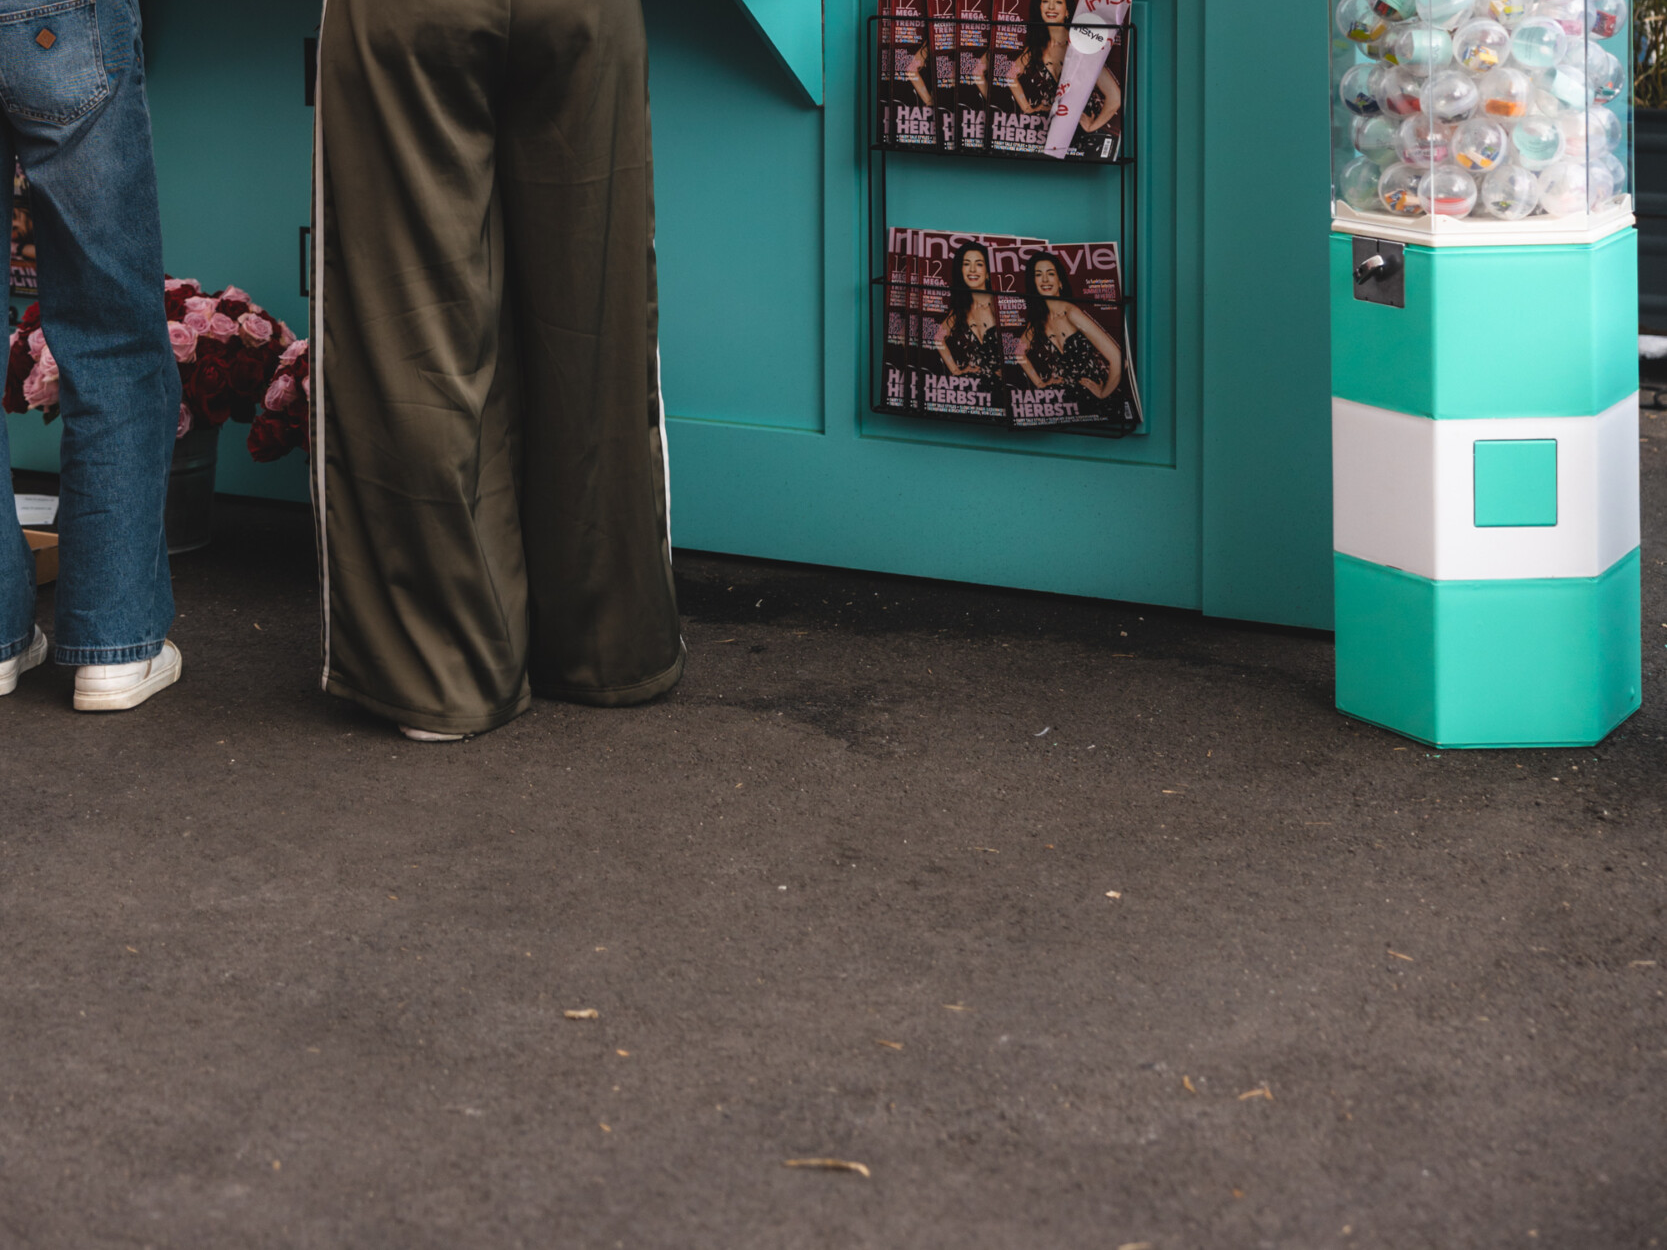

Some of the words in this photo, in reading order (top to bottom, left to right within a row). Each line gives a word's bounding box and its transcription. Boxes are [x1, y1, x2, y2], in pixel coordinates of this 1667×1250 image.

[923, 260, 943, 278] 12
[924, 374, 981, 392] HAPPY
[924, 387, 992, 407] HERBST!
[1011, 389, 1066, 404] HAPPY
[1011, 401, 1080, 418] HERBST!
